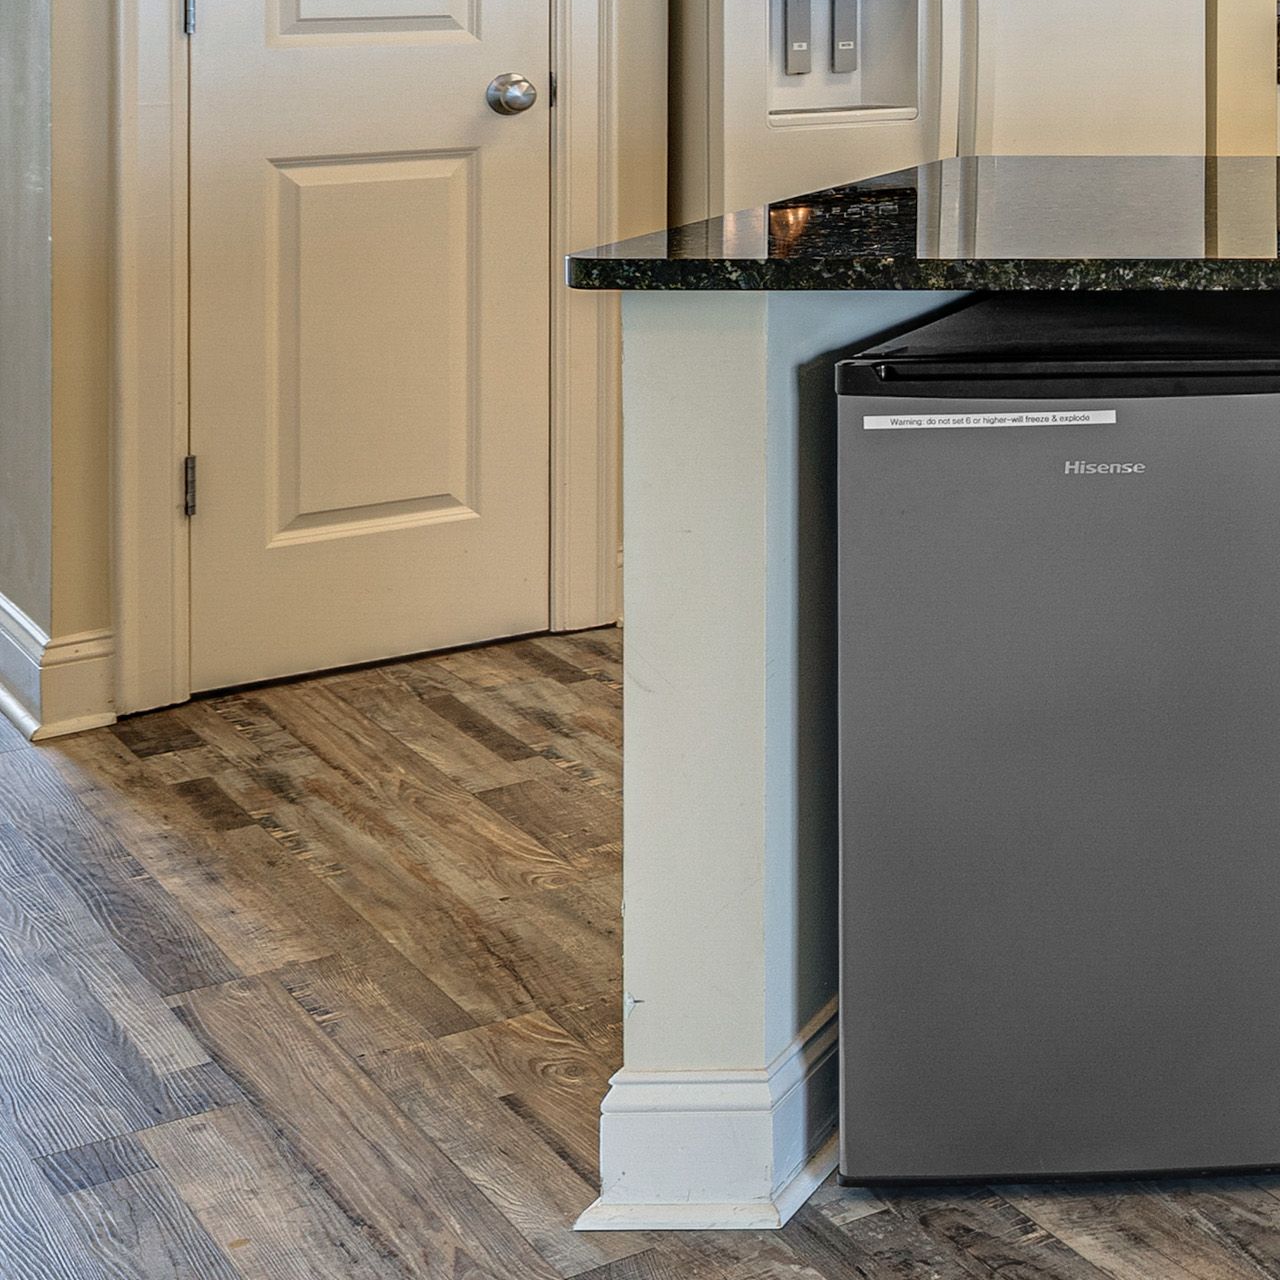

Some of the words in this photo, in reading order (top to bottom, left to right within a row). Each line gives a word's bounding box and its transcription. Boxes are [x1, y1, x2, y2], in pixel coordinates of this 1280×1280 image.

[889, 418, 925, 426] Warning:
[926, 417, 937, 425] do
[938, 417, 951, 425] not
[1025, 415, 1050, 423] freeze
[1051, 414, 1058, 423] &
[1059, 414, 1091, 423] explode
[1064, 460, 1147, 475] Hisense
